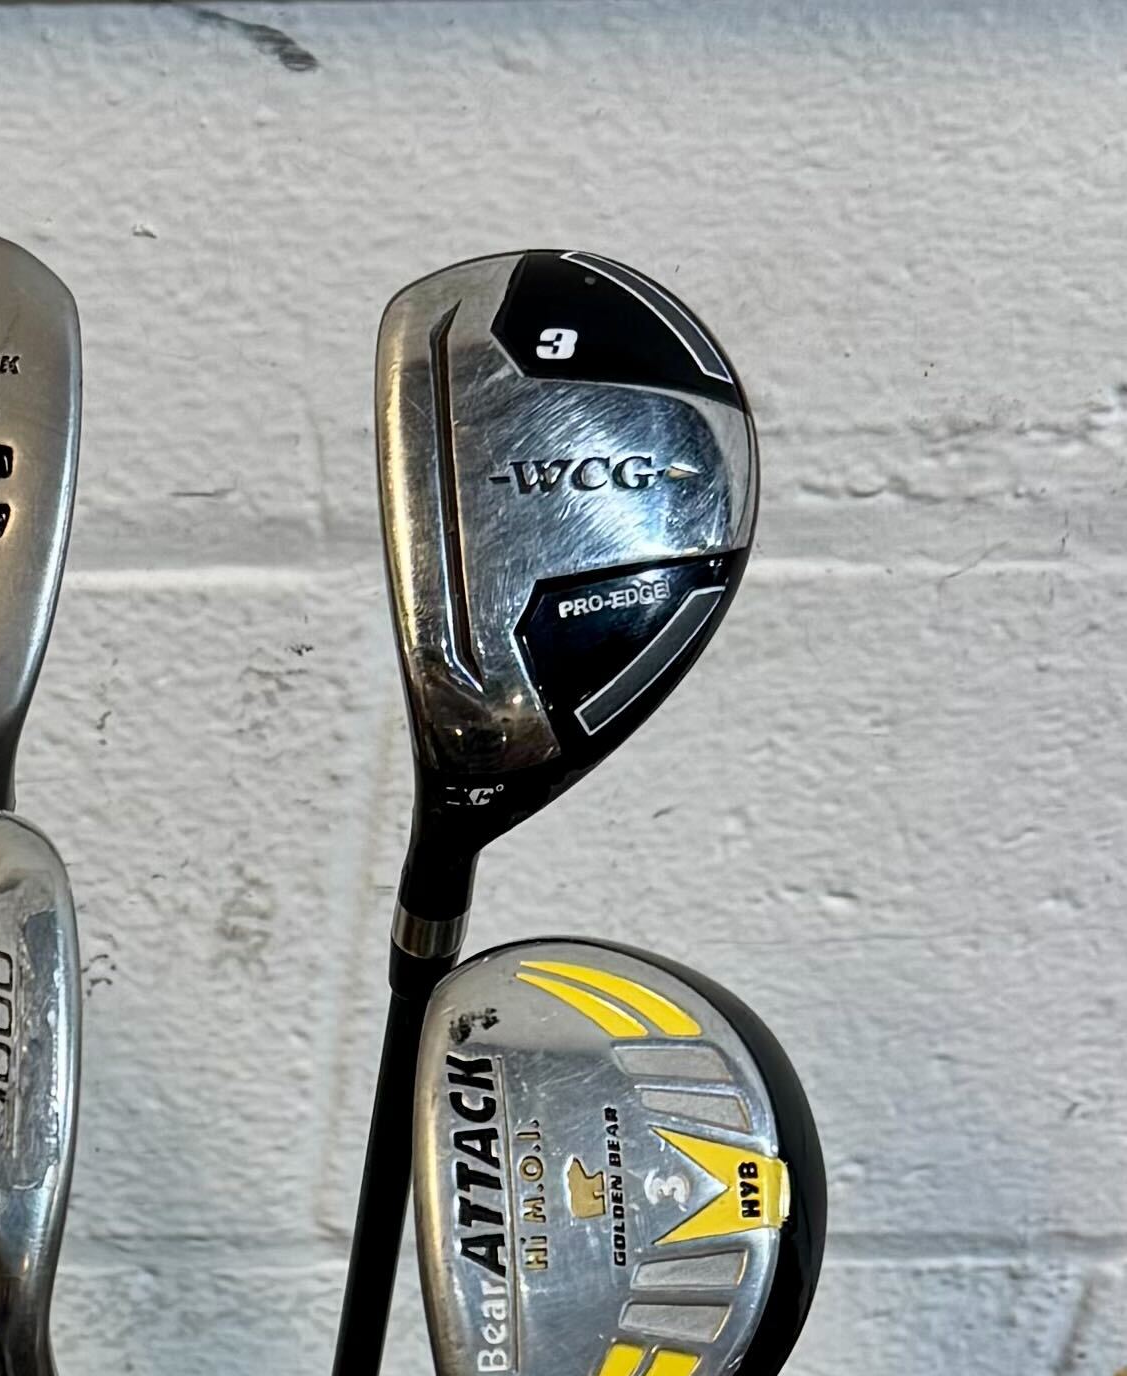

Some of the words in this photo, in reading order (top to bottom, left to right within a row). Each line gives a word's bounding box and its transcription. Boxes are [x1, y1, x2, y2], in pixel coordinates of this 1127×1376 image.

[536, 327, 578, 360] 3
[559, 581, 670, 618] PRO-EDGE
[446, 1052, 507, 1278] ATTACK
[603, 1106, 623, 1170] BEAR
[643, 1173, 689, 1205] 3
[737, 1160, 761, 1219] HYB
[609, 1173, 628, 1267] GOLDEN
[477, 1277, 508, 1374] Bear
